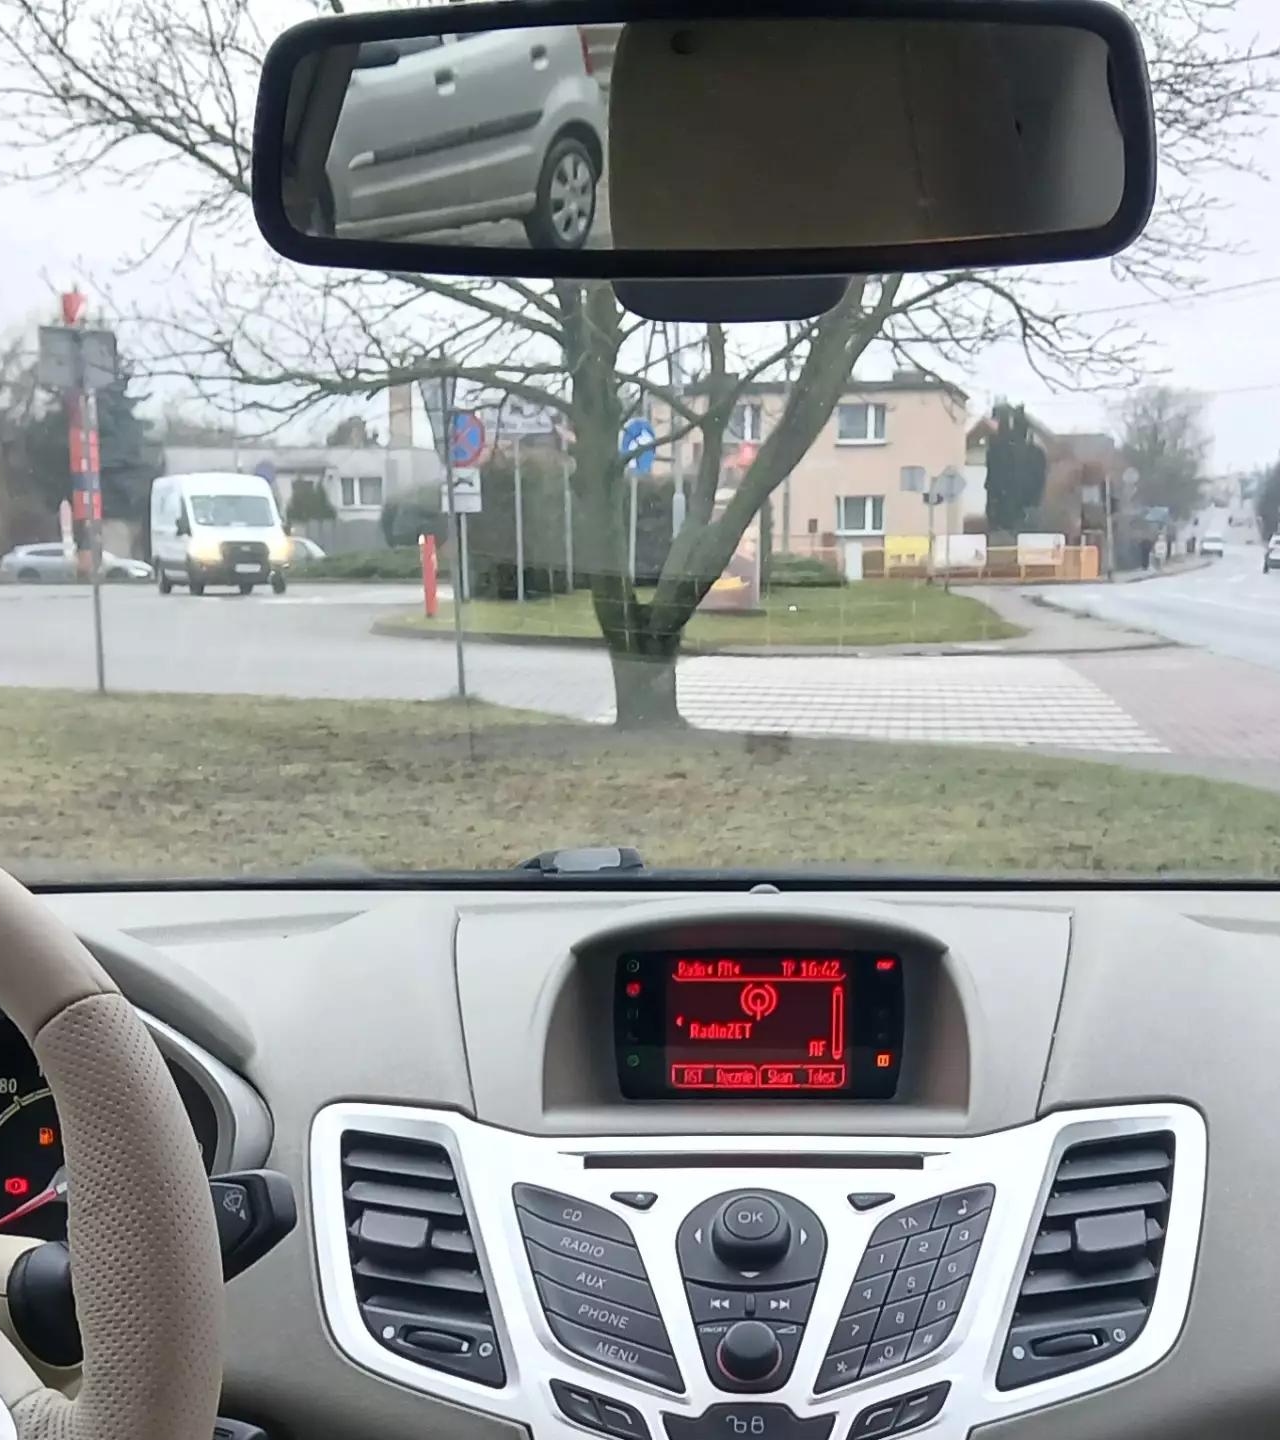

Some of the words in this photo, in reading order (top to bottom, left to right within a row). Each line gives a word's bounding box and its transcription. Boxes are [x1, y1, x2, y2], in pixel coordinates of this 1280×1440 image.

[678, 961, 705, 976] Radio
[800, 961, 840, 976] 16:42
[689, 1023, 752, 1039] RadioZET
[562, 1208, 582, 1222] CD
[737, 1211, 764, 1224] OK
[897, 1216, 918, 1230] TA
[958, 1229, 970, 1241] 3
[560, 1236, 605, 1258] RADIO
[919, 1241, 929, 1253] 2
[947, 1262, 957, 1273] 6
[576, 1271, 607, 1290] AUX
[906, 1276, 916, 1289] 5
[862, 1288, 872, 1300] 4
[936, 1300, 946, 1311] 9
[578, 1304, 630, 1329] PHONE
[895, 1312, 905, 1324] 8
[851, 1324, 860, 1336] 7
[596, 1341, 639, 1364] MENU
